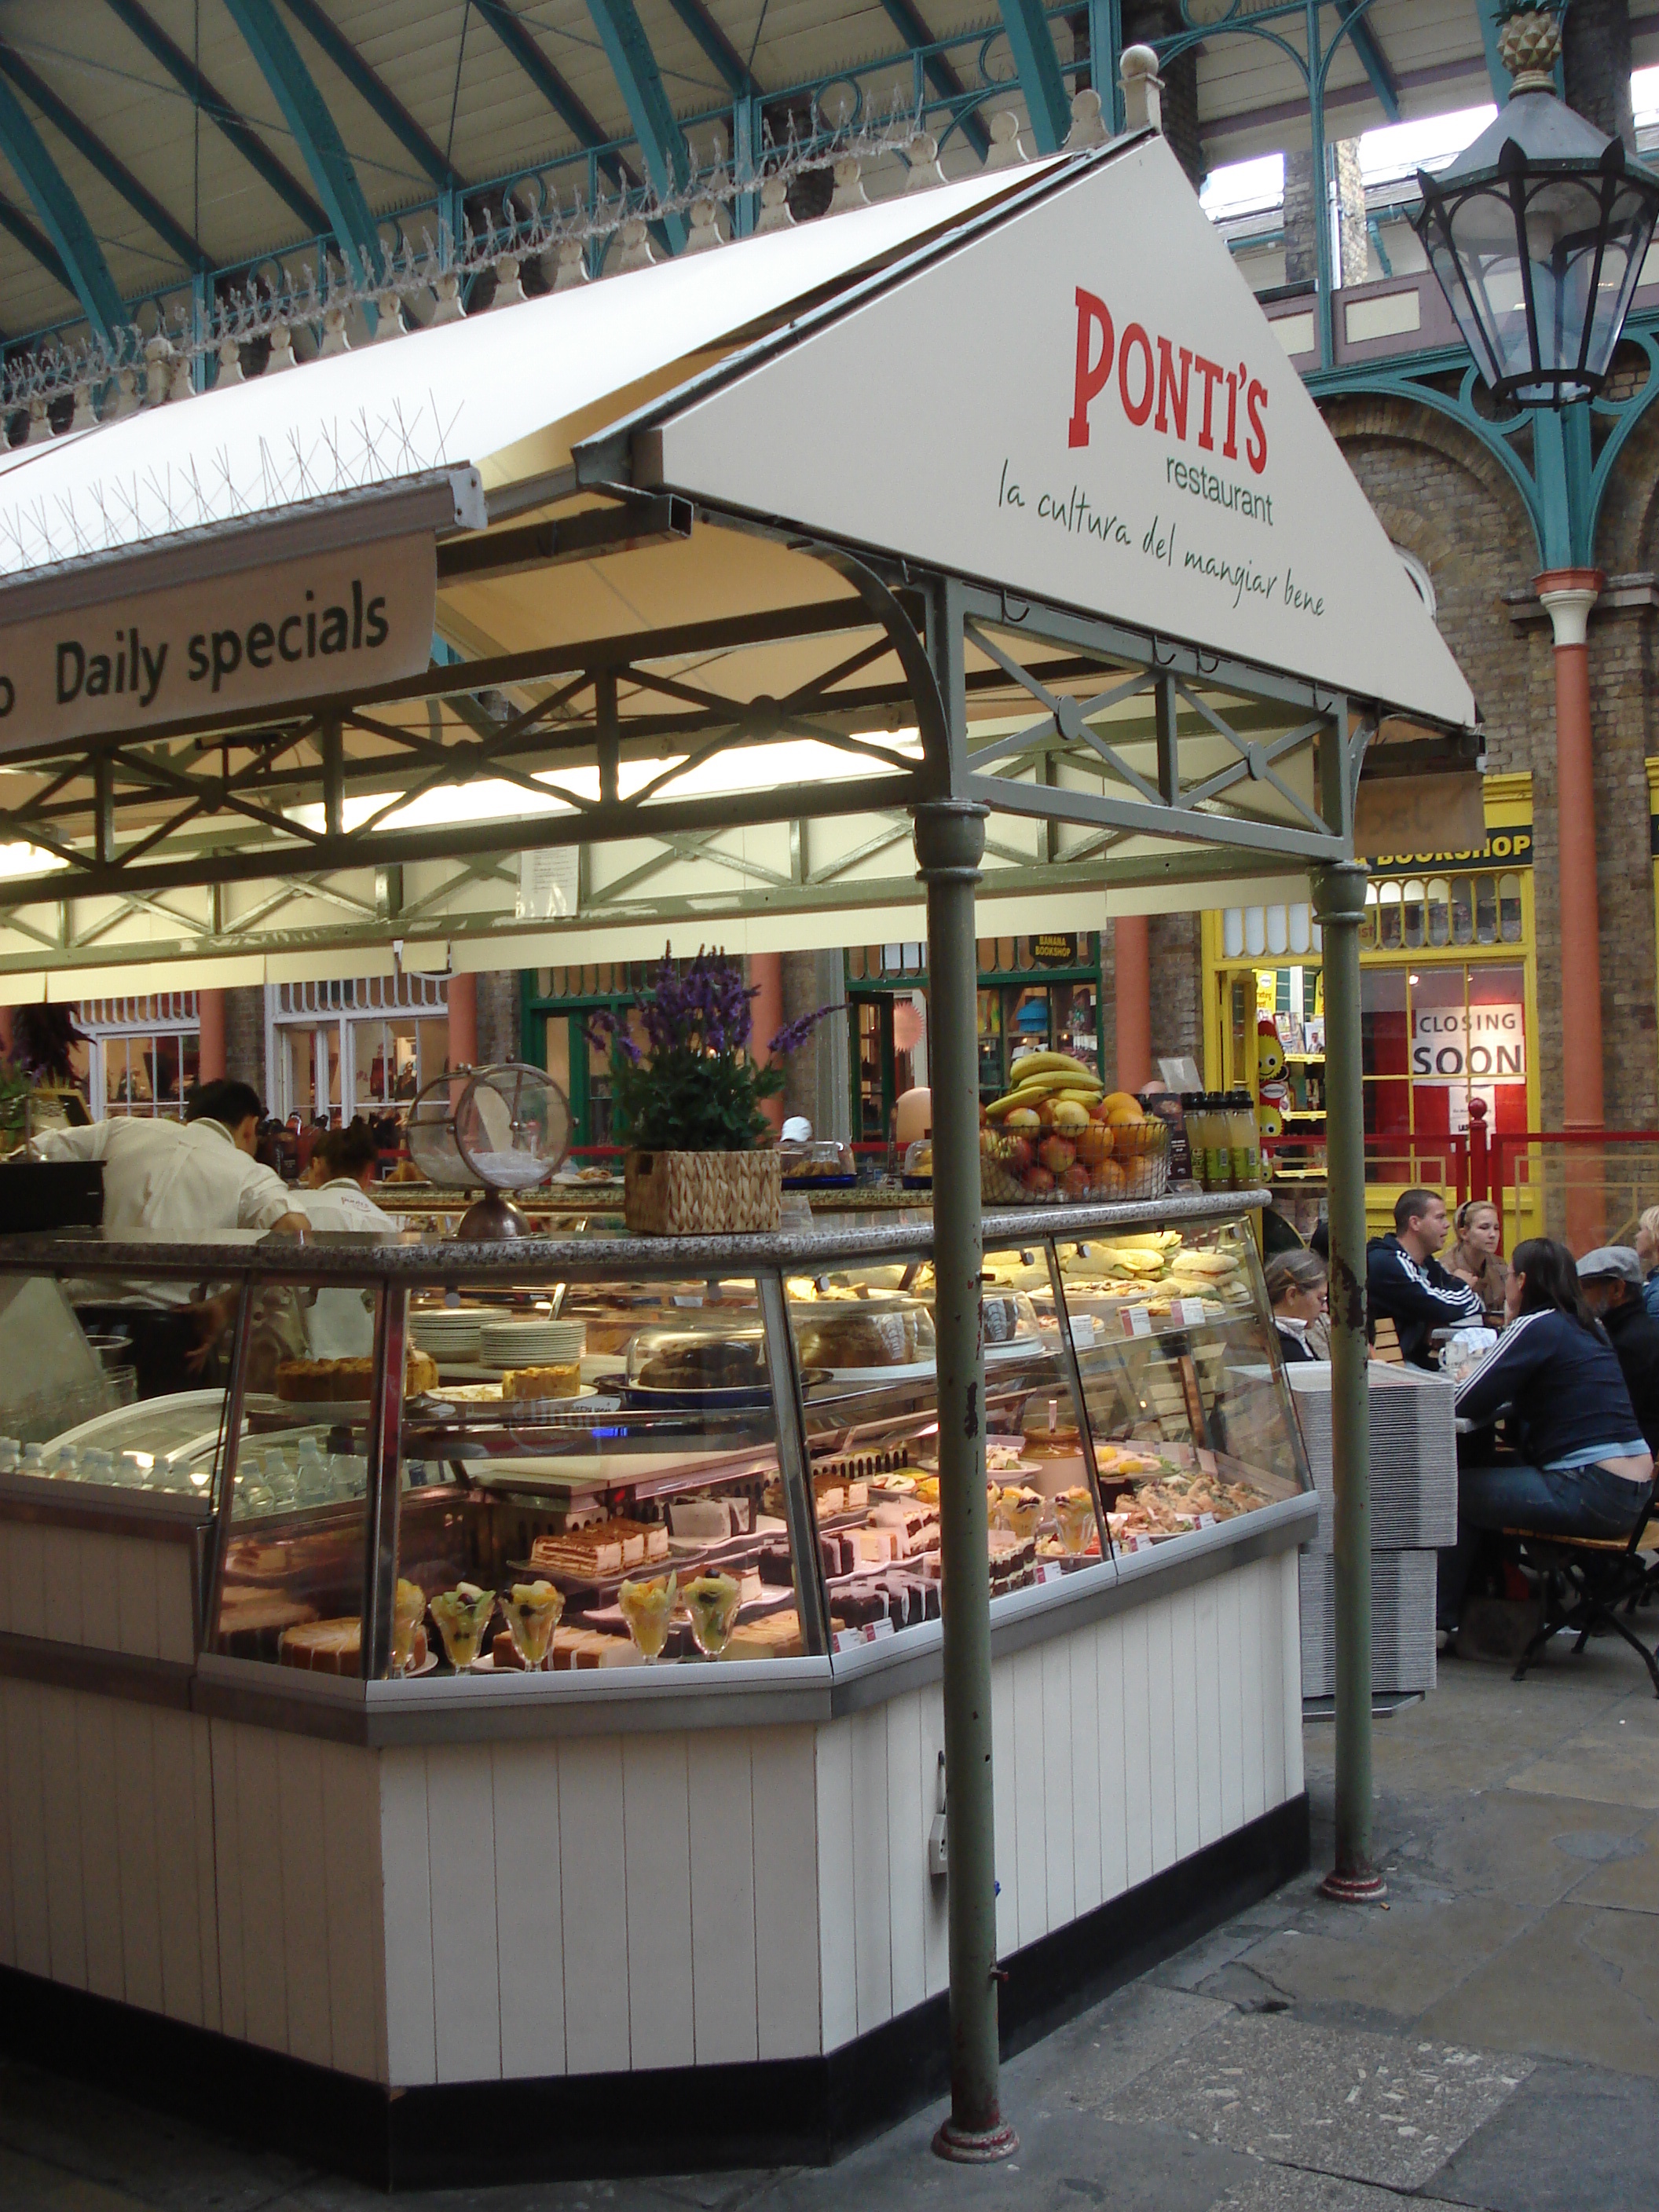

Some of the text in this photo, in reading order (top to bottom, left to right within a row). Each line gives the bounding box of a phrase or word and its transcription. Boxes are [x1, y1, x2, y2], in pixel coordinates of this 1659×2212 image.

[1068, 286, 1269, 474] PONTI'S
[1166, 456, 1274, 526] restaurant
[998, 458, 1325, 617] la cultura del mangiar bene
[57, 628, 168, 707] Daily
[188, 580, 390, 693] specials
[1035, 946, 1071, 957] BOOKSHOP
[1039, 936, 1066, 946] BANANA
[1419, 1013, 1515, 1033] CLOSING
[1412, 1044, 1522, 1075] SOON
